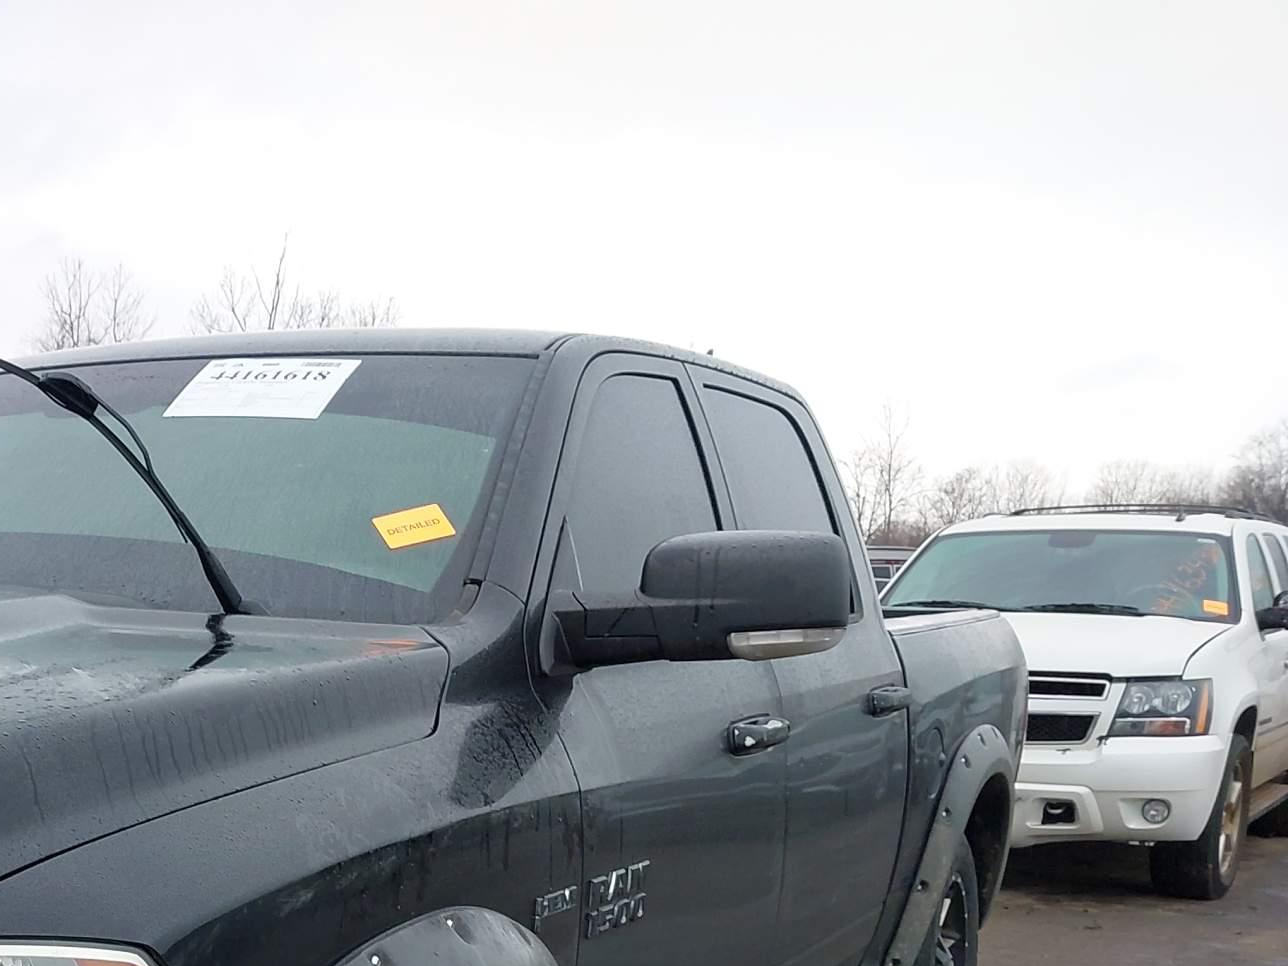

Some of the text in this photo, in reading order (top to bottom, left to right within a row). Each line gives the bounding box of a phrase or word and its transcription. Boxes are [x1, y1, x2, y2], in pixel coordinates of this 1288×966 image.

[209, 369, 331, 381] 44161618
[386, 518, 441, 536] DETAILED
[586, 892, 648, 939] 1500
